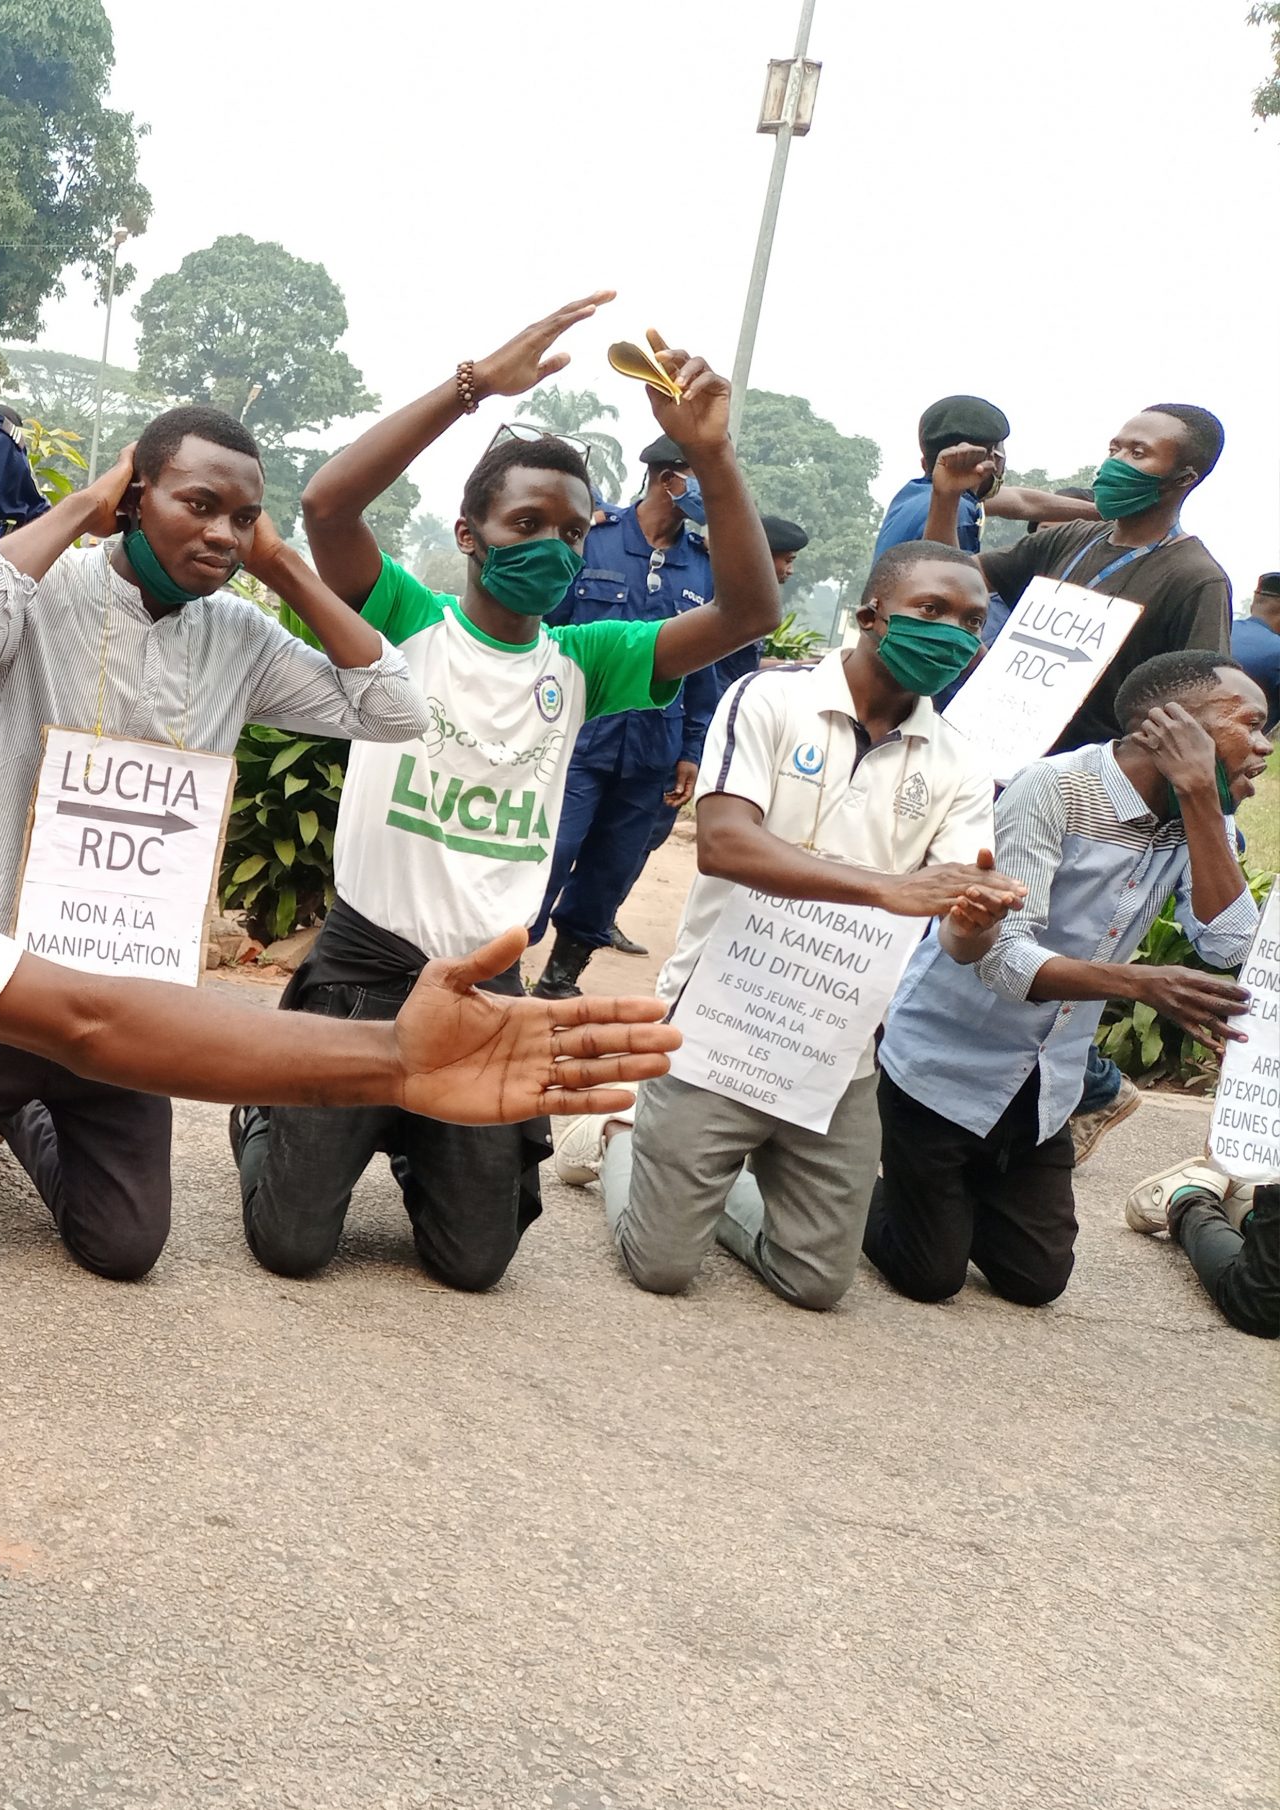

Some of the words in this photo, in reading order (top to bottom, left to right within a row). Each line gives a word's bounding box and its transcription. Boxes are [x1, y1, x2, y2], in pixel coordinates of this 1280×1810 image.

[1018, 601, 1106, 650] LUCHA
[1005, 650, 1066, 687] RDC
[60, 750, 200, 811] LUCHA
[391, 753, 551, 839] LUCHA
[78, 827, 165, 876] RDC
[60, 900, 106, 925] NON
[112, 908, 126, 927] A
[133, 909, 156, 931] LA
[747, 890, 894, 951] MUKUMBANYI
[26, 932, 181, 968] MANIPULATION
[744, 915, 775, 940] NA
[780, 927, 872, 974] KANEMU
[727, 941, 766, 967] MU
[769, 957, 861, 1006] DITUNGA
[718, 972, 734, 987] JE
[734, 976, 765, 997] SUIS
[763, 985, 807, 1016] JEUNE,
[806, 1007, 826, 1023] JE
[826, 1011, 848, 1030] DIS
[744, 1003, 774, 1024] NON
[776, 1012, 788, 1027] A
[790, 1018, 805, 1035] LA
[1261, 1000, 1278, 1023] LA
[695, 1004, 802, 1054] DISCRIMINATION
[802, 1044, 837, 1067] DANS
[747, 1044, 770, 1061] LES
[706, 1071, 778, 1105] PUBLIQUES
[707, 1049, 794, 1091] INSTITUTIONS
[1217, 1107, 1268, 1135] JEUNES
[1216, 1136, 1240, 1159] DES
